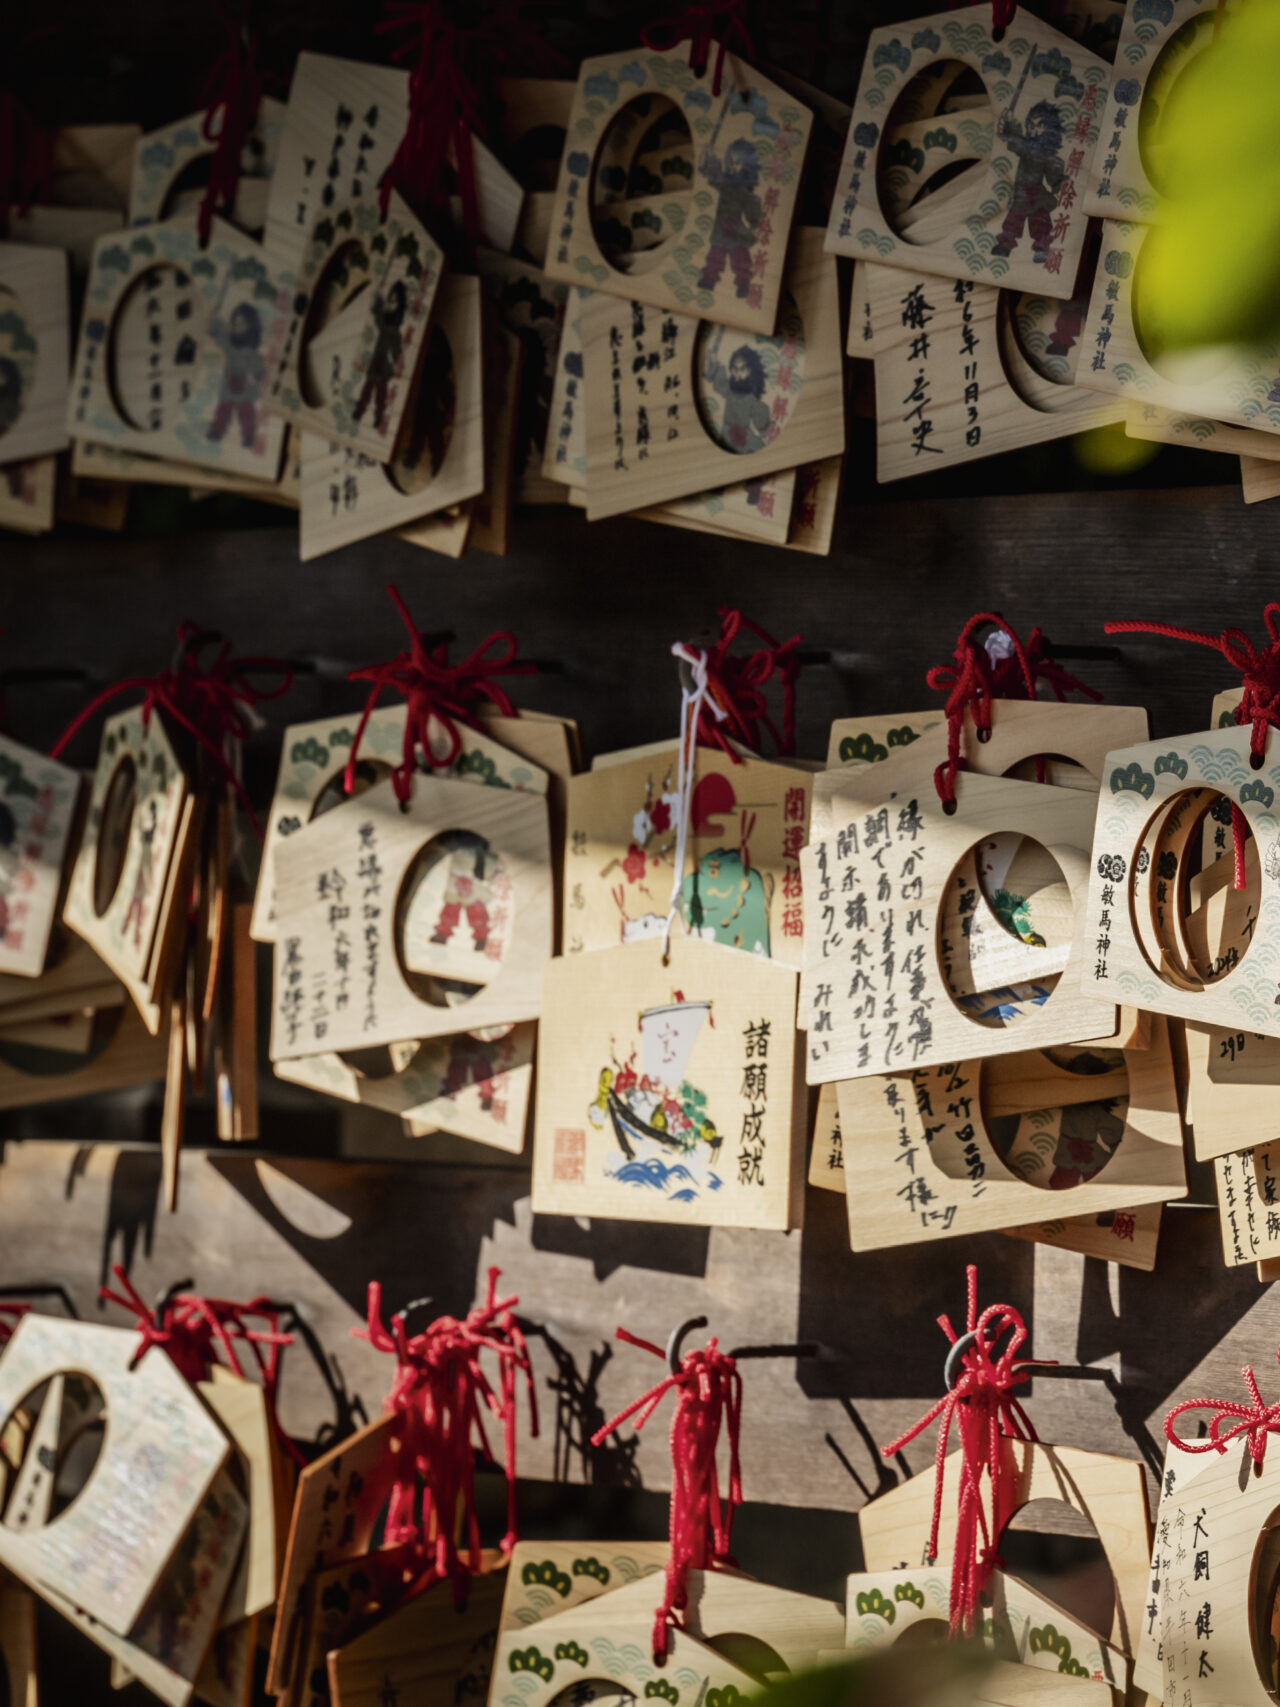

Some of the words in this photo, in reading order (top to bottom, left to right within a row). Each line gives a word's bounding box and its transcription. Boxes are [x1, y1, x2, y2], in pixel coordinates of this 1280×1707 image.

[783, 787, 807, 938] 開運招福
[1093, 883, 1116, 981] 敏馬神社
[736, 1017, 772, 1187] 諸願成就
